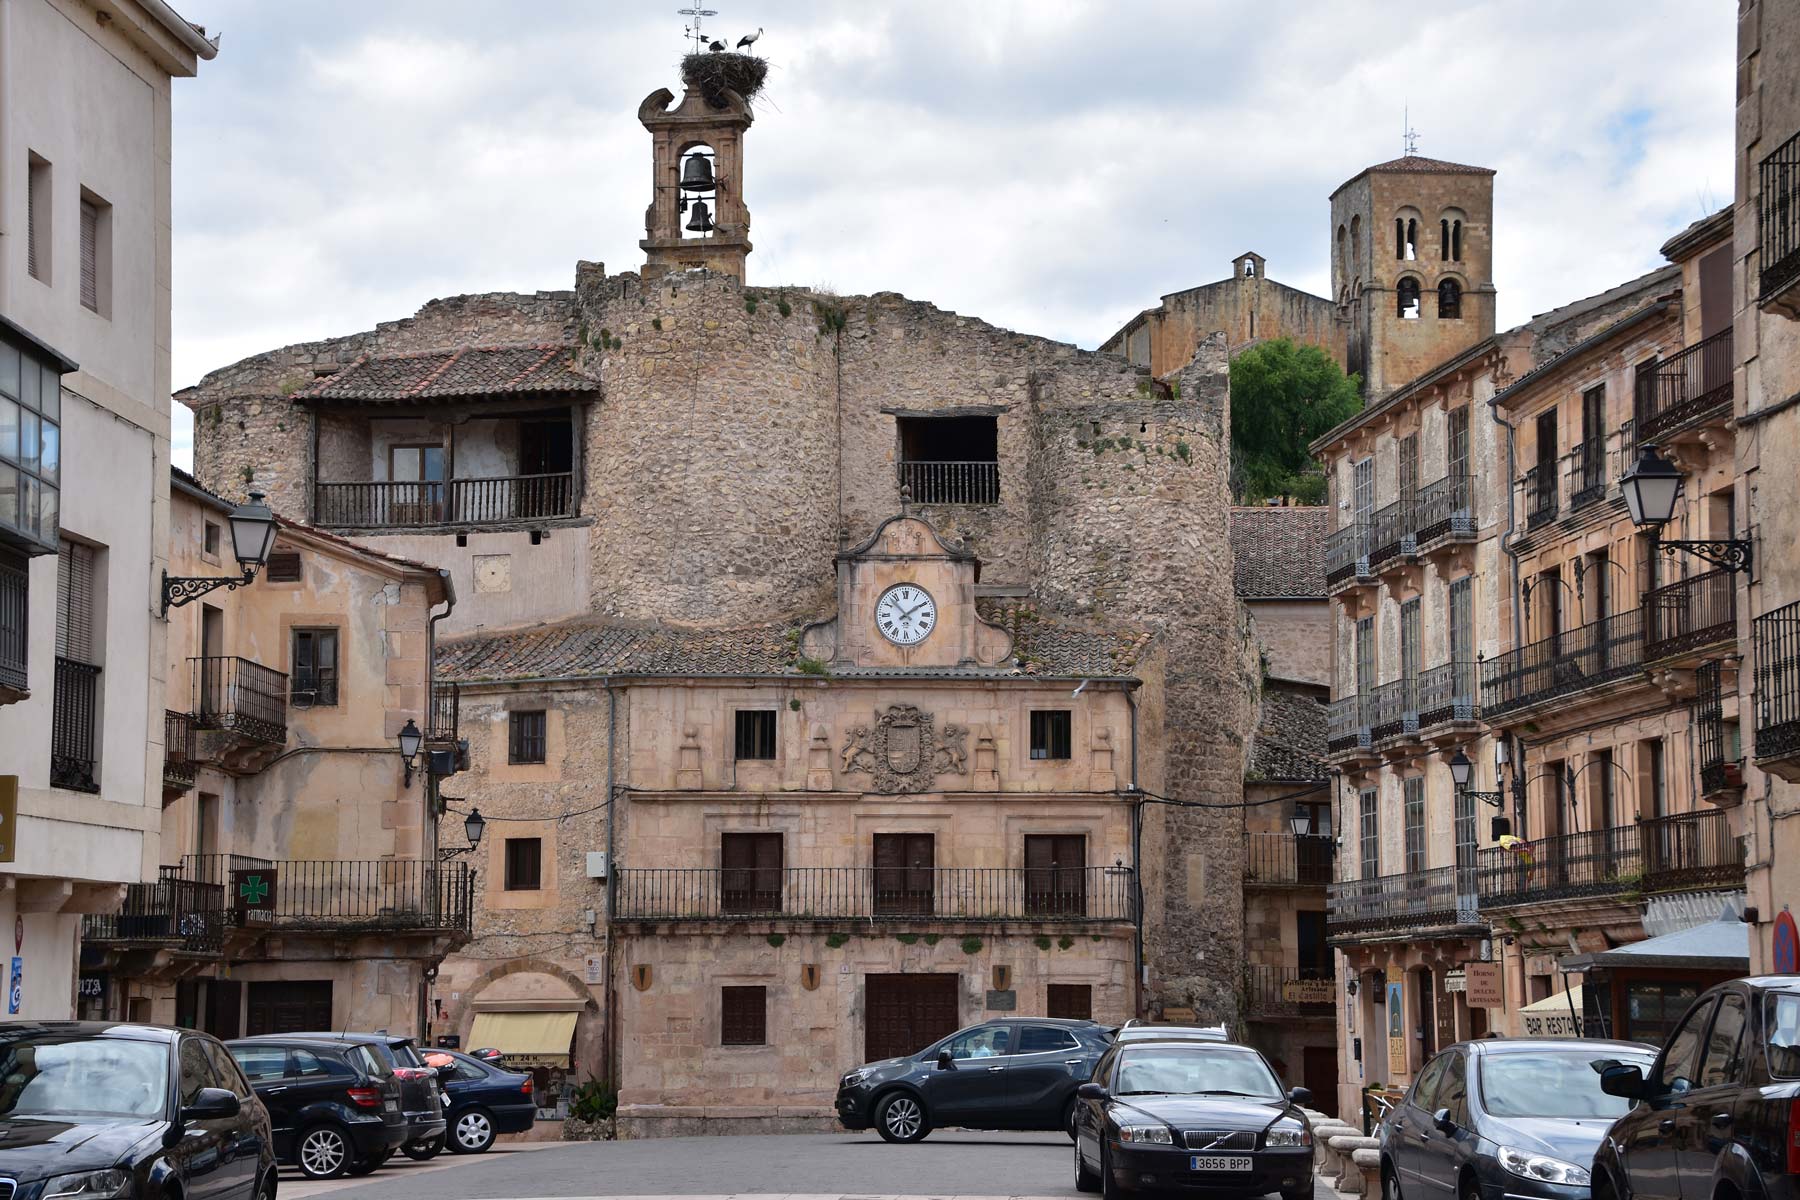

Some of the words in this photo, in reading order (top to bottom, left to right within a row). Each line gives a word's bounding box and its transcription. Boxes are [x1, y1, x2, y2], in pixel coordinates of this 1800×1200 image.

[1526, 1017, 1543, 1035] BAR
[1546, 1015, 1584, 1035] RESTAR
[1199, 1158, 1226, 1169] 3656
[1229, 1158, 1250, 1169] BPP
